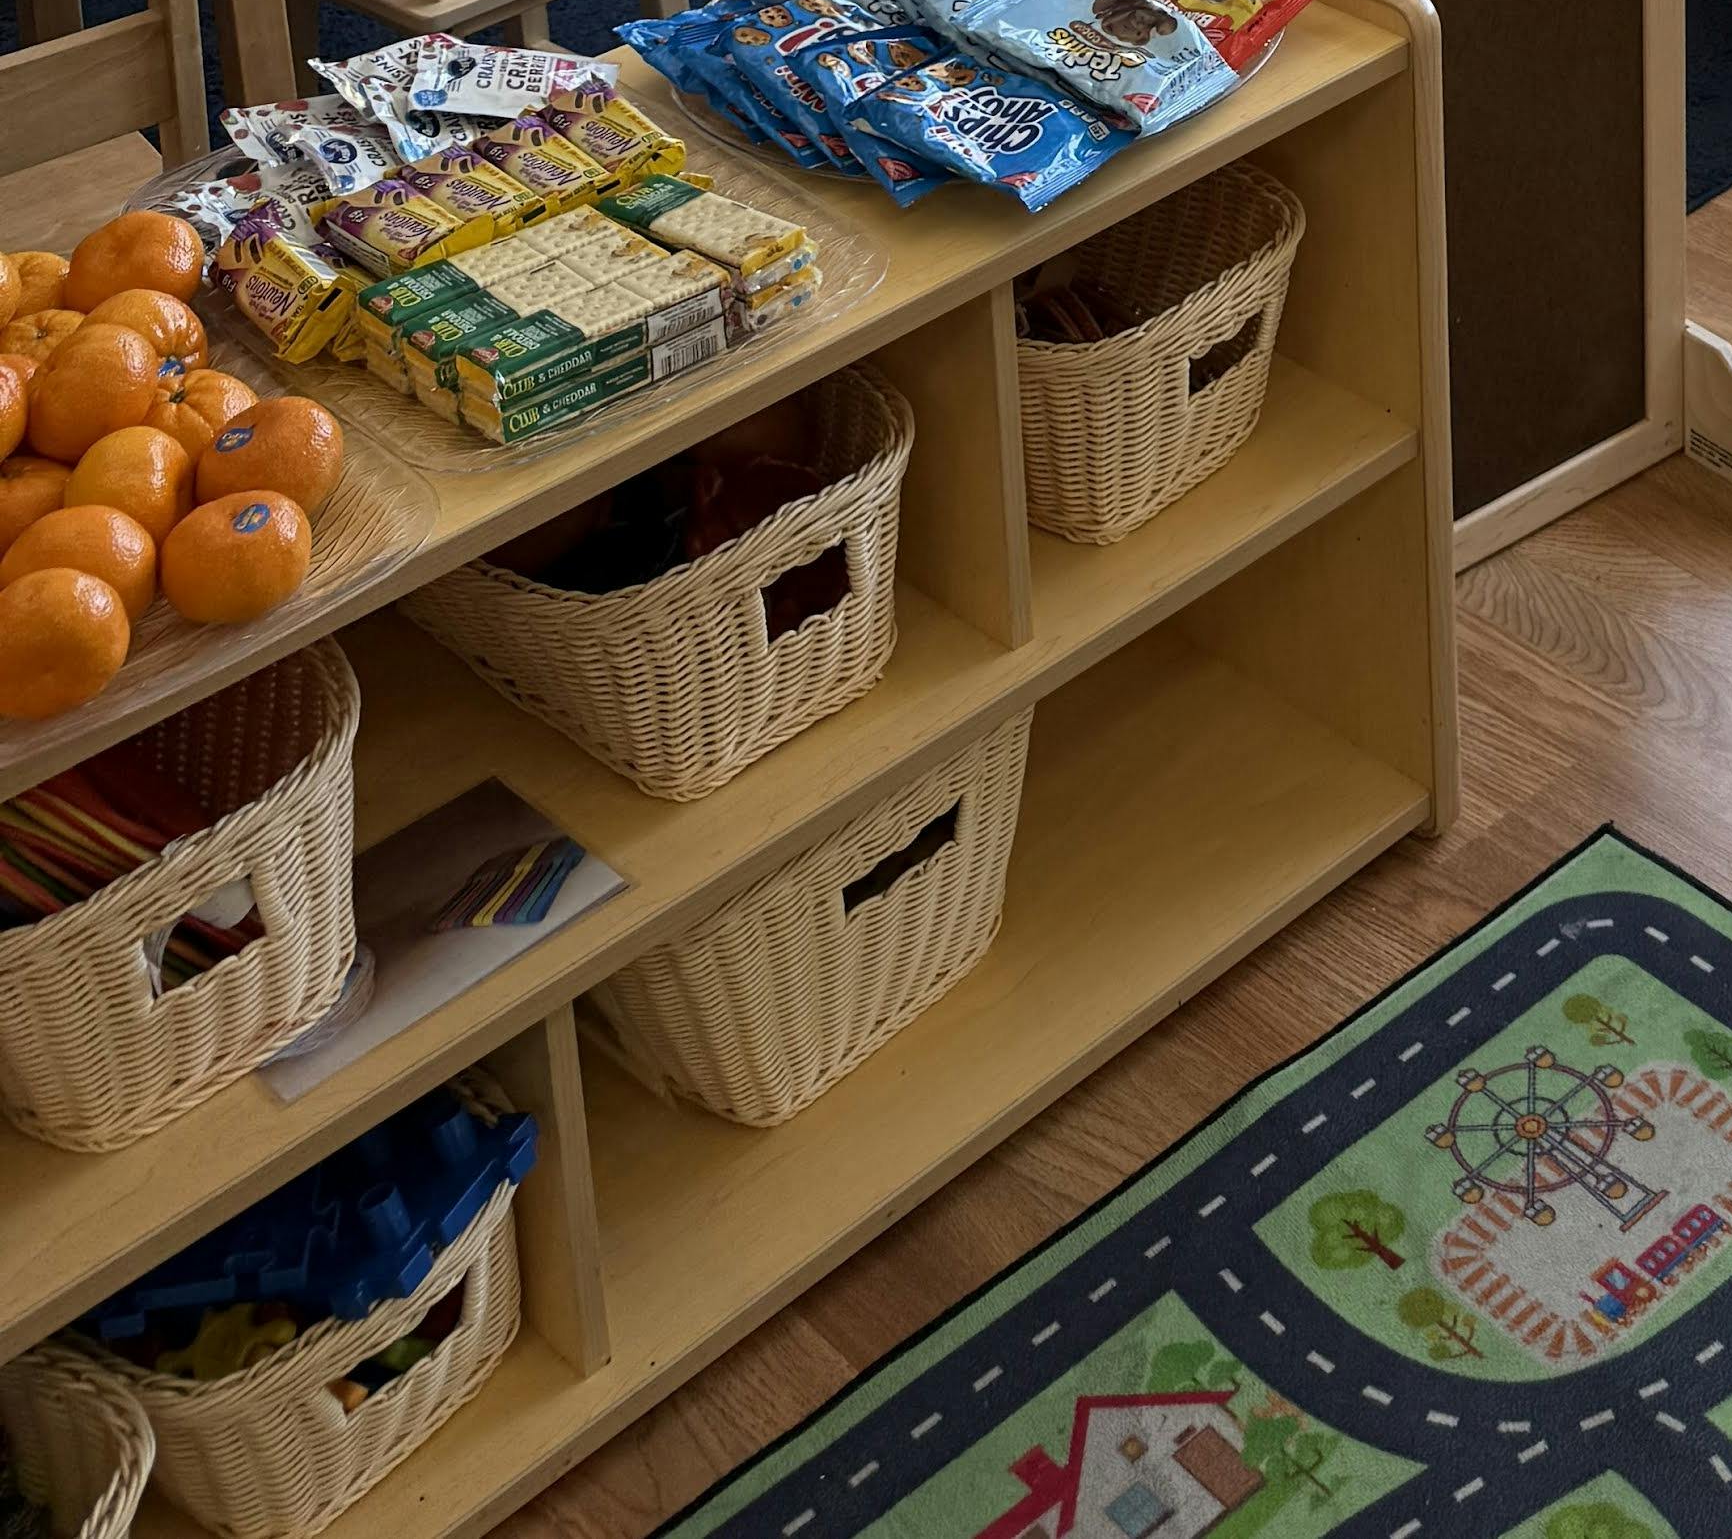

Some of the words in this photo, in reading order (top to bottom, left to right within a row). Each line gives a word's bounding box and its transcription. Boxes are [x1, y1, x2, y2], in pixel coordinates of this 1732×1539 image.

[581, 119, 642, 156] Newtons
[943, 104, 1042, 156] Chips
[520, 152, 582, 187] Newtons
[446, 178, 512, 211] Newtons
[379, 209, 437, 239] Newtons
[247, 275, 299, 317] Newtons
[548, 350, 593, 384] CHEDDAR
[508, 407, 541, 433] CLUB
[552, 382, 597, 410] CHEDDAR
